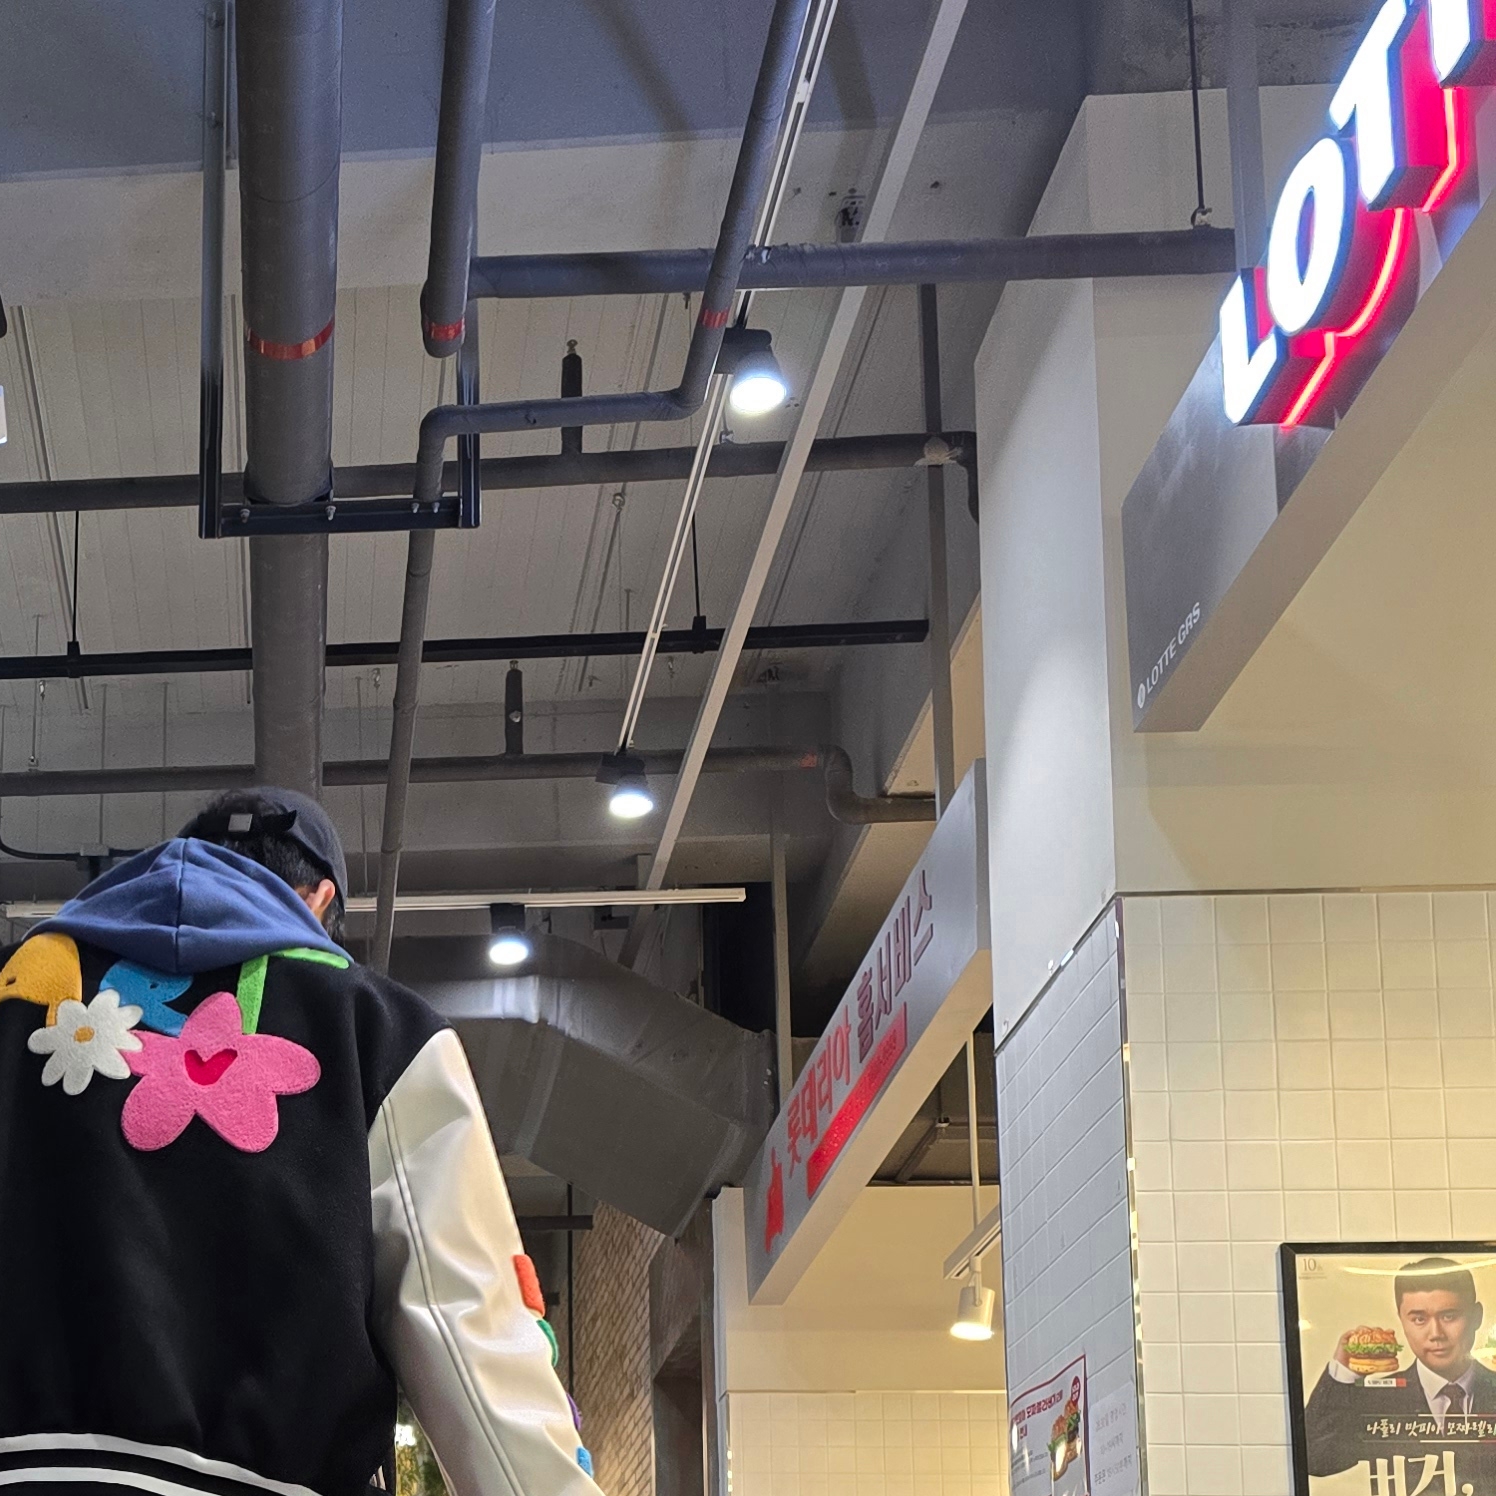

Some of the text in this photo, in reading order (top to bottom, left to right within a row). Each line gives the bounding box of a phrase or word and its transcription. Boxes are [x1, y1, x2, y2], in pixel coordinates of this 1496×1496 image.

[1147, 637, 1177, 694] LOTTE
[788, 1005, 851, 1178] 롯데리아
[857, 870, 933, 1063] 홈서비스
[1366, 1419, 1401, 1438] 나폴리
[1405, 1421, 1442, 1437] 맛피아
